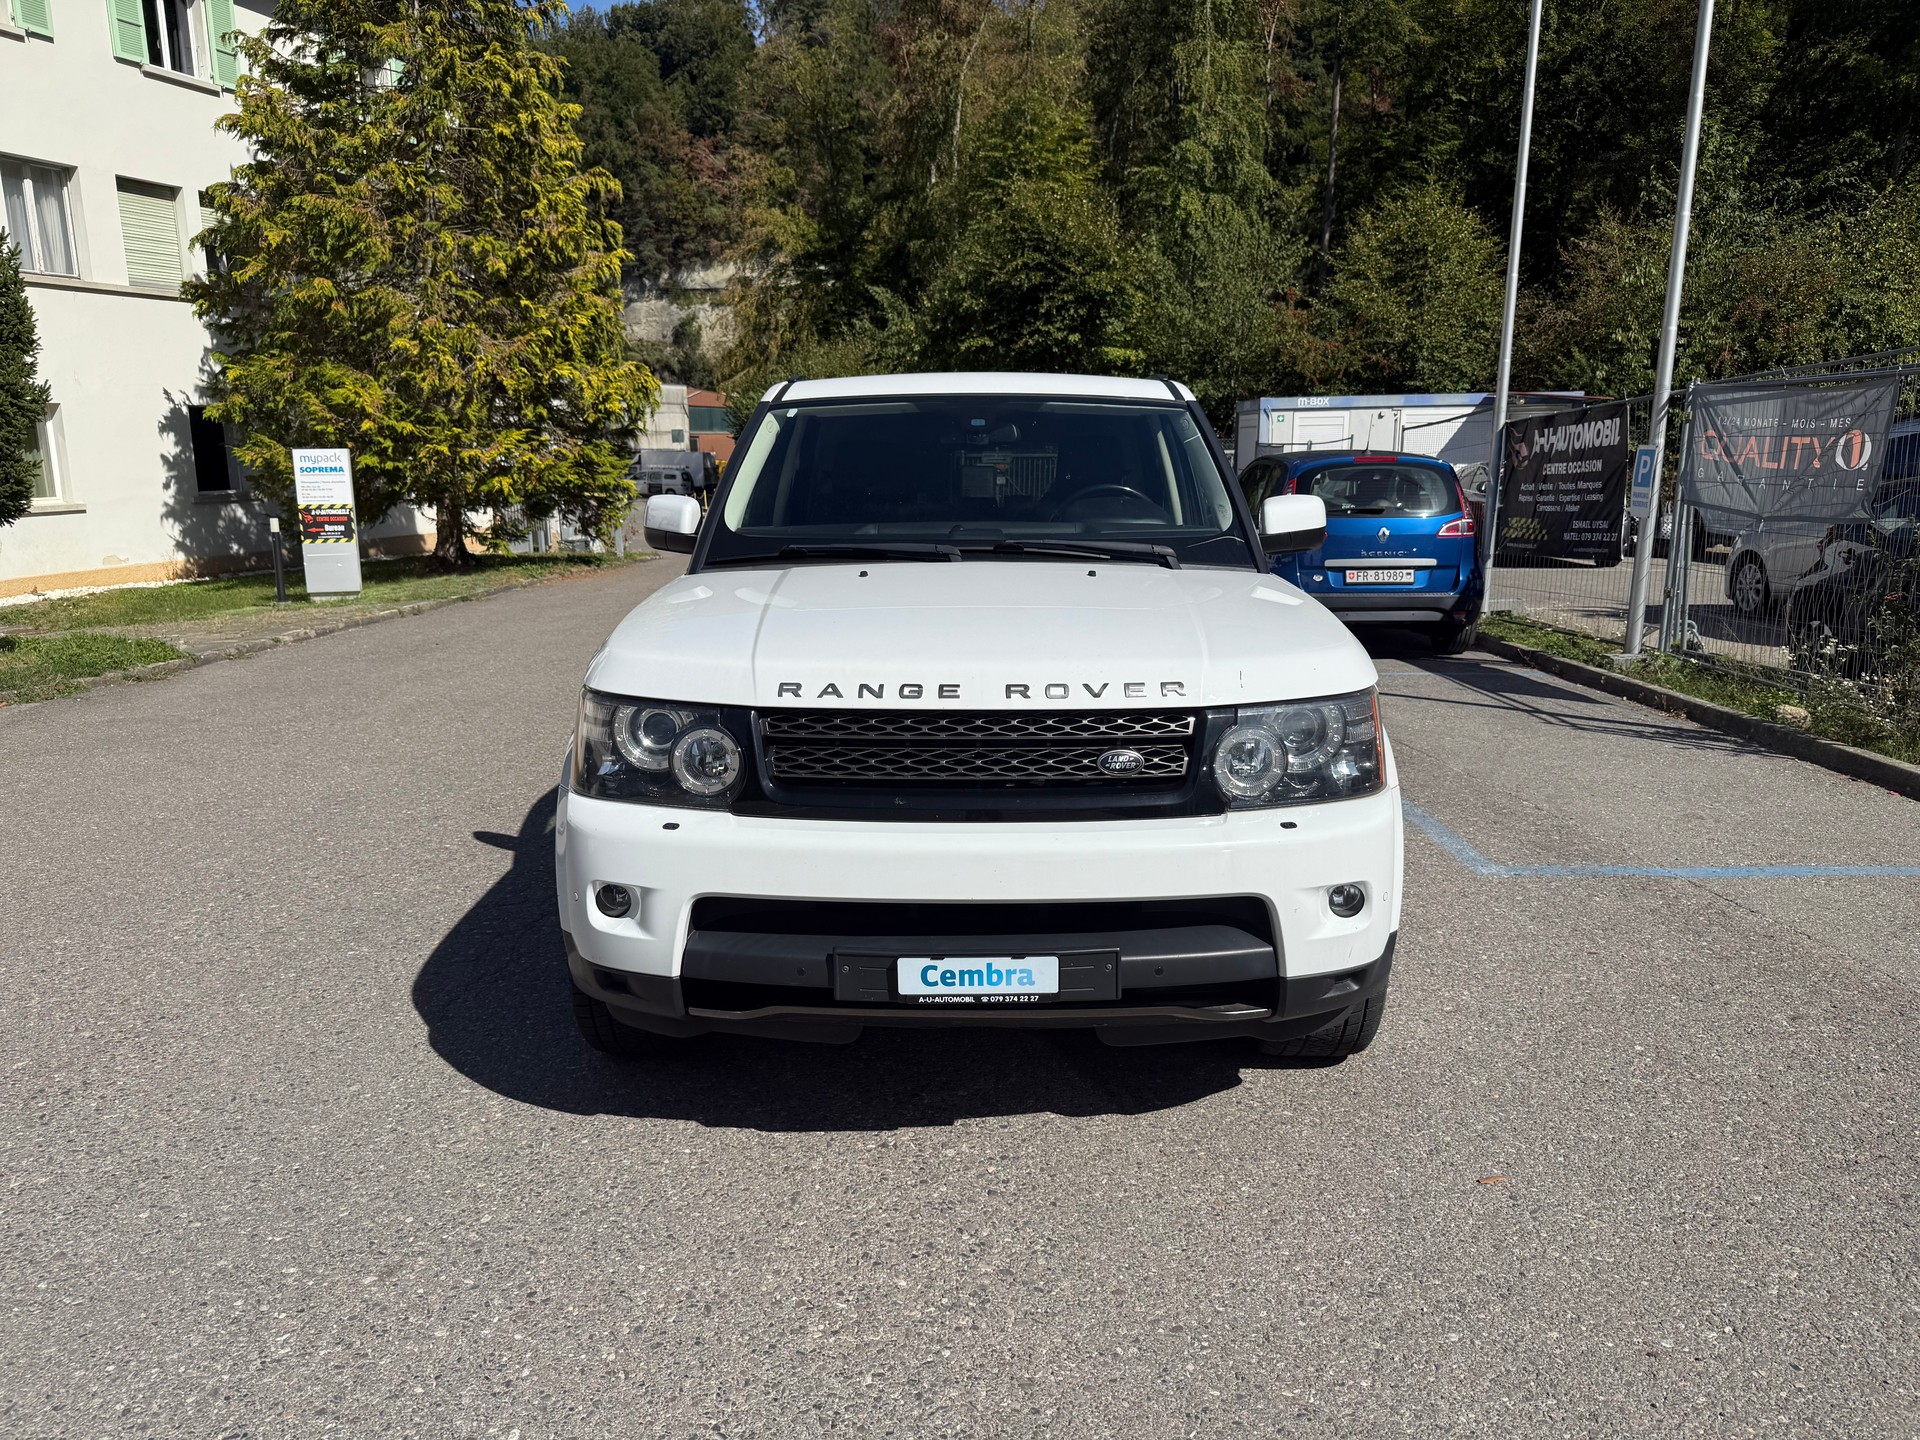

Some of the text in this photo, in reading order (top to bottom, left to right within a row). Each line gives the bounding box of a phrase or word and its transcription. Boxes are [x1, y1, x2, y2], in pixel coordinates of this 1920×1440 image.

[1718, 417, 1740, 427] 12/24
[1744, 418, 1779, 427] MONATE
[1792, 419, 1816, 429] MOIS
[1830, 417, 1851, 428] MES
[1530, 418, 1620, 460] A-U-AUTOMOBIL
[1702, 430, 1836, 470] QUALITY
[299, 452, 342, 465] mypack
[299, 466, 344, 474] SOPREMA
[1542, 460, 1602, 475] CENTRE OCCASION
[1637, 455, 1651, 483] P
[1521, 483, 1535, 491] Achat
[1539, 482, 1554, 490] Vente
[1559, 482, 1576, 490] Toutes
[1577, 481, 1602, 490] Marques
[1698, 468, 1865, 492] GARANTIE
[1536, 494, 1555, 502] Garantie
[1559, 493, 1580, 503] Expertise
[1584, 492, 1604, 502] Leasing
[1592, 521, 1609, 529] UYSAL
[1581, 533, 1592, 541] 079
[1592, 533, 1602, 541] 374
[1603, 533, 1610, 542] 22
[1611, 533, 1618, 542] 27
[778, 682, 1186, 699] RANGE ROVER
[920, 962, 1035, 988] Cembra
